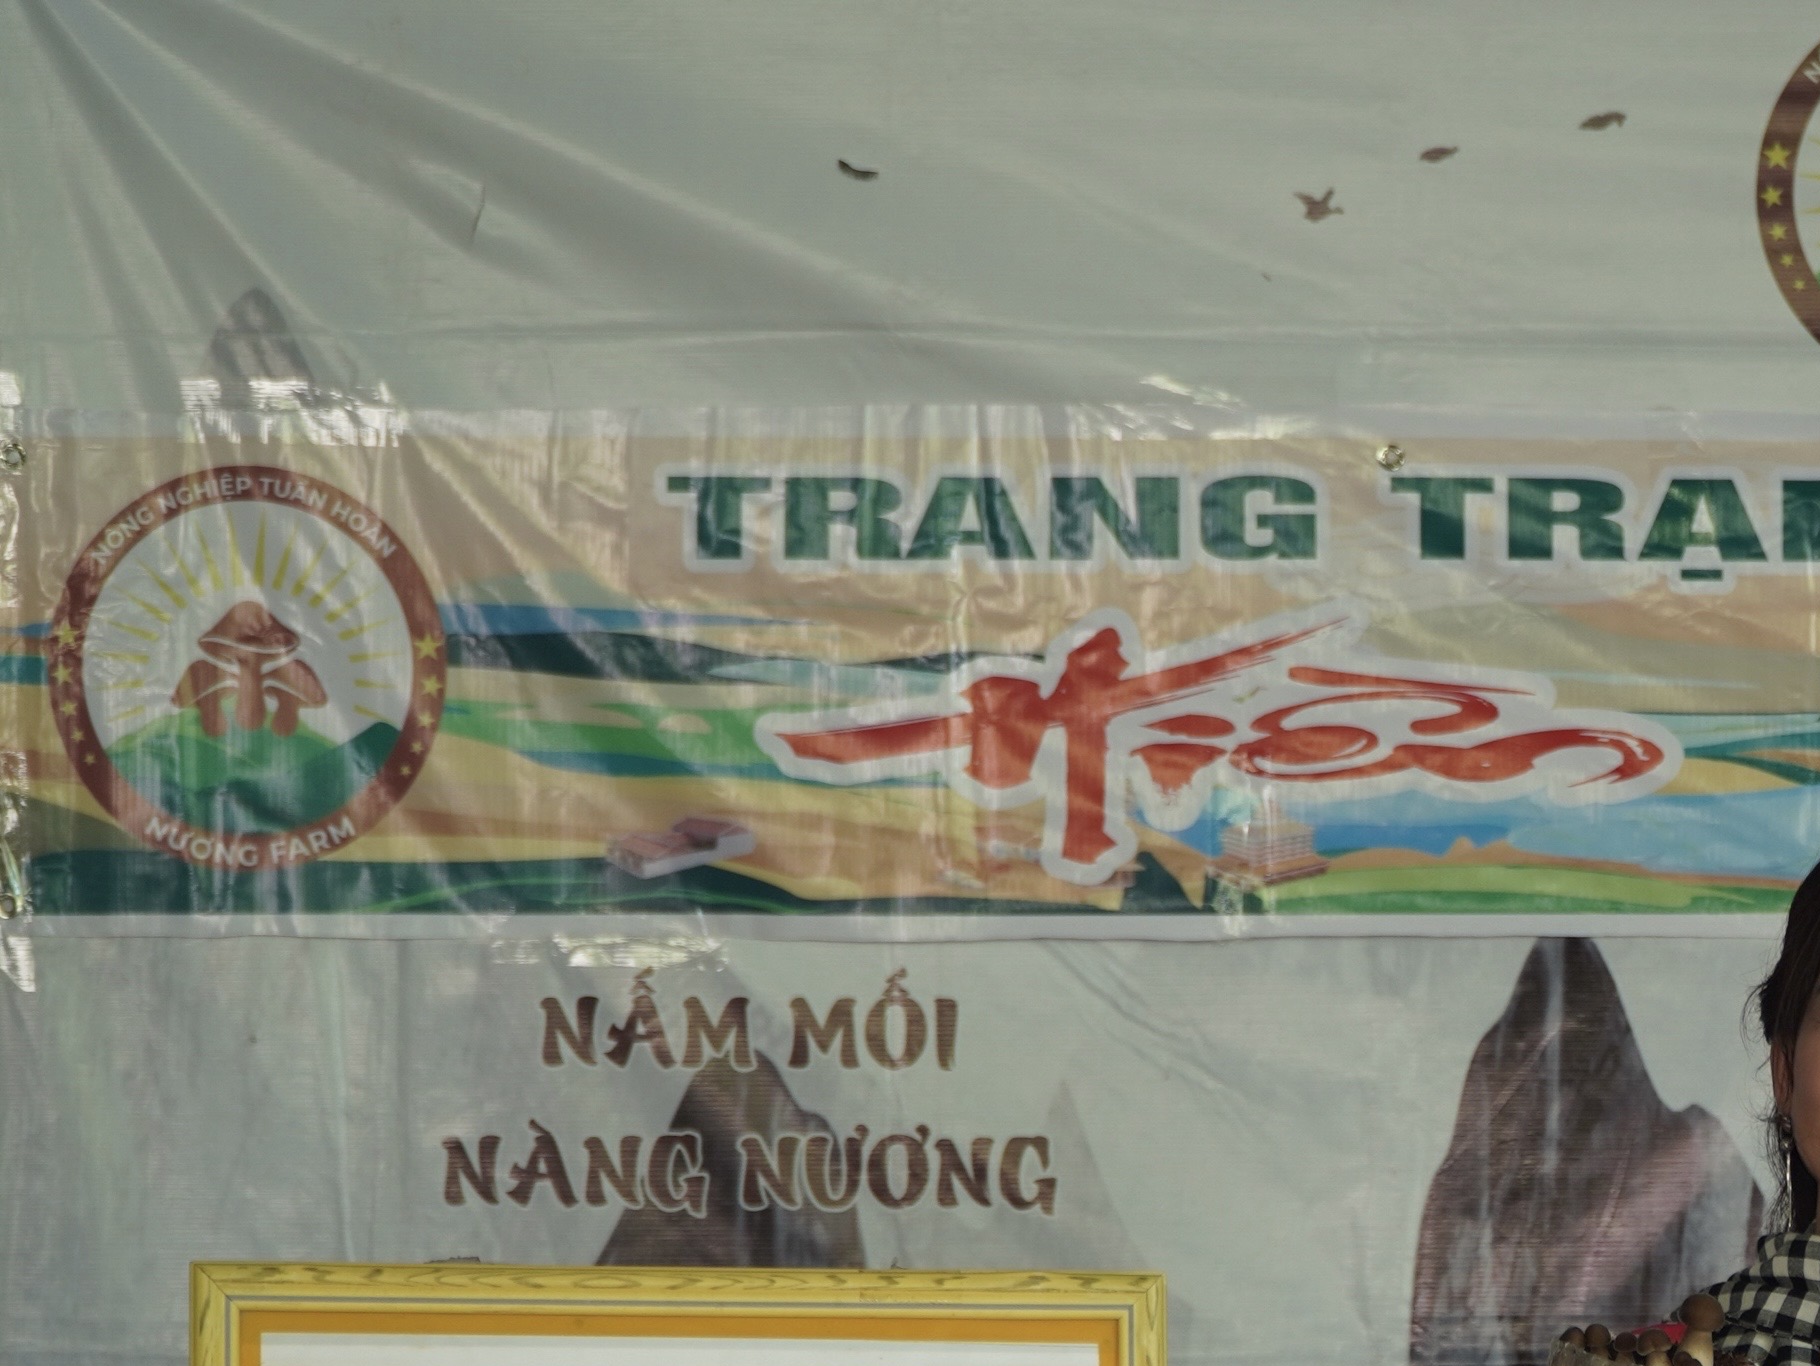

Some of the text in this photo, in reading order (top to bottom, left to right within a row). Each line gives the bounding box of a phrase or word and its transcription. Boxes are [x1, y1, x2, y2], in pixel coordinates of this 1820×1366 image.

[91, 508, 155, 568] NÔNG
[157, 474, 252, 519] NGHIỆP
[330, 501, 398, 557] HOÀN
[666, 476, 1318, 560] TRANG
[144, 816, 356, 868] NƯƠNG FARM
[540, 966, 958, 1070] NẤM MỐI
[443, 1118, 1056, 1217] NÀNG NƯƠNG
